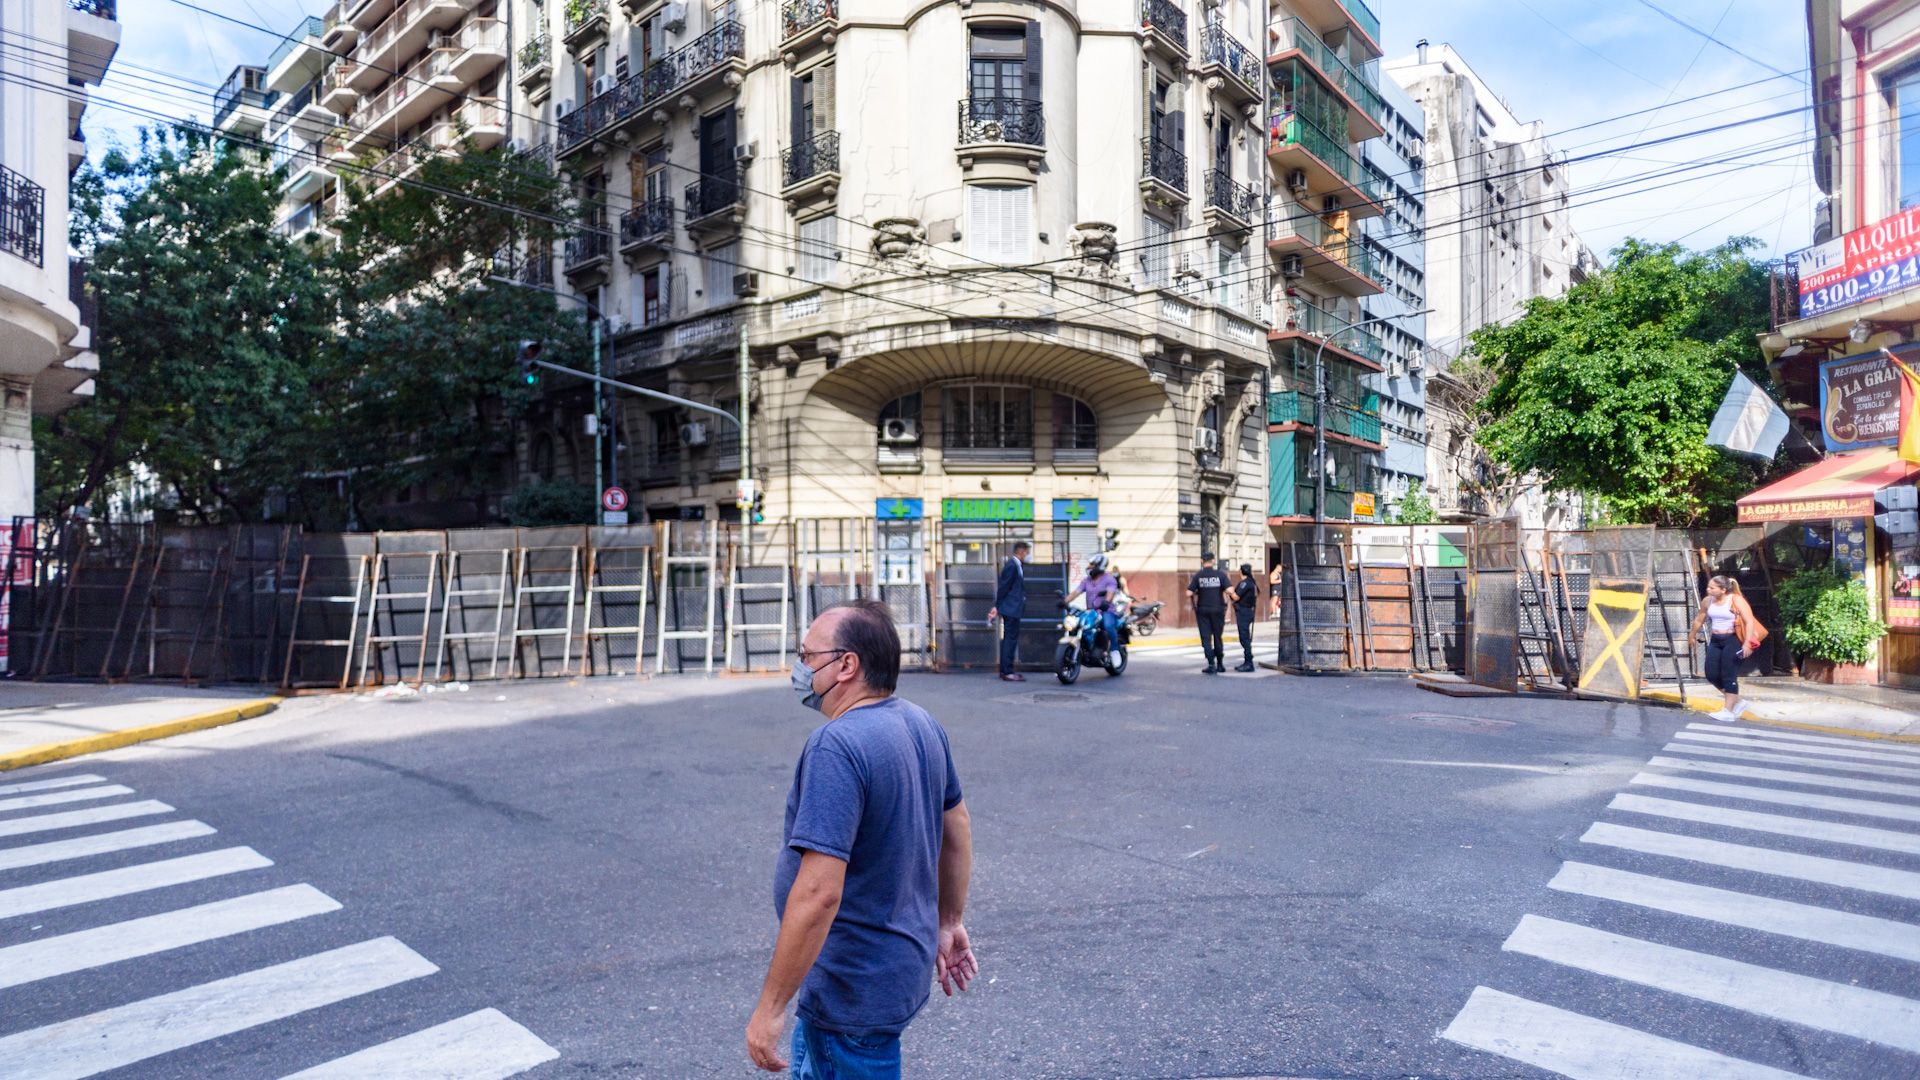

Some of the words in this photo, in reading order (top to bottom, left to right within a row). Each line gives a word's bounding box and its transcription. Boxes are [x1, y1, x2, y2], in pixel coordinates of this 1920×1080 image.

[1847, 215, 1920, 258] ALQUIL
[1801, 256, 1920, 311] 4300-924
[1834, 359, 1888, 377] RESTAURANTE
[1843, 379, 1862, 397] LA
[1864, 366, 1902, 387] GRAN
[1858, 423, 1884, 435] BUENOS
[942, 499, 1032, 519] FARMACIA
[1741, 506, 1754, 516] LA
[1755, 504, 1789, 515] GRAN
[1790, 500, 1848, 512] TABERNA
